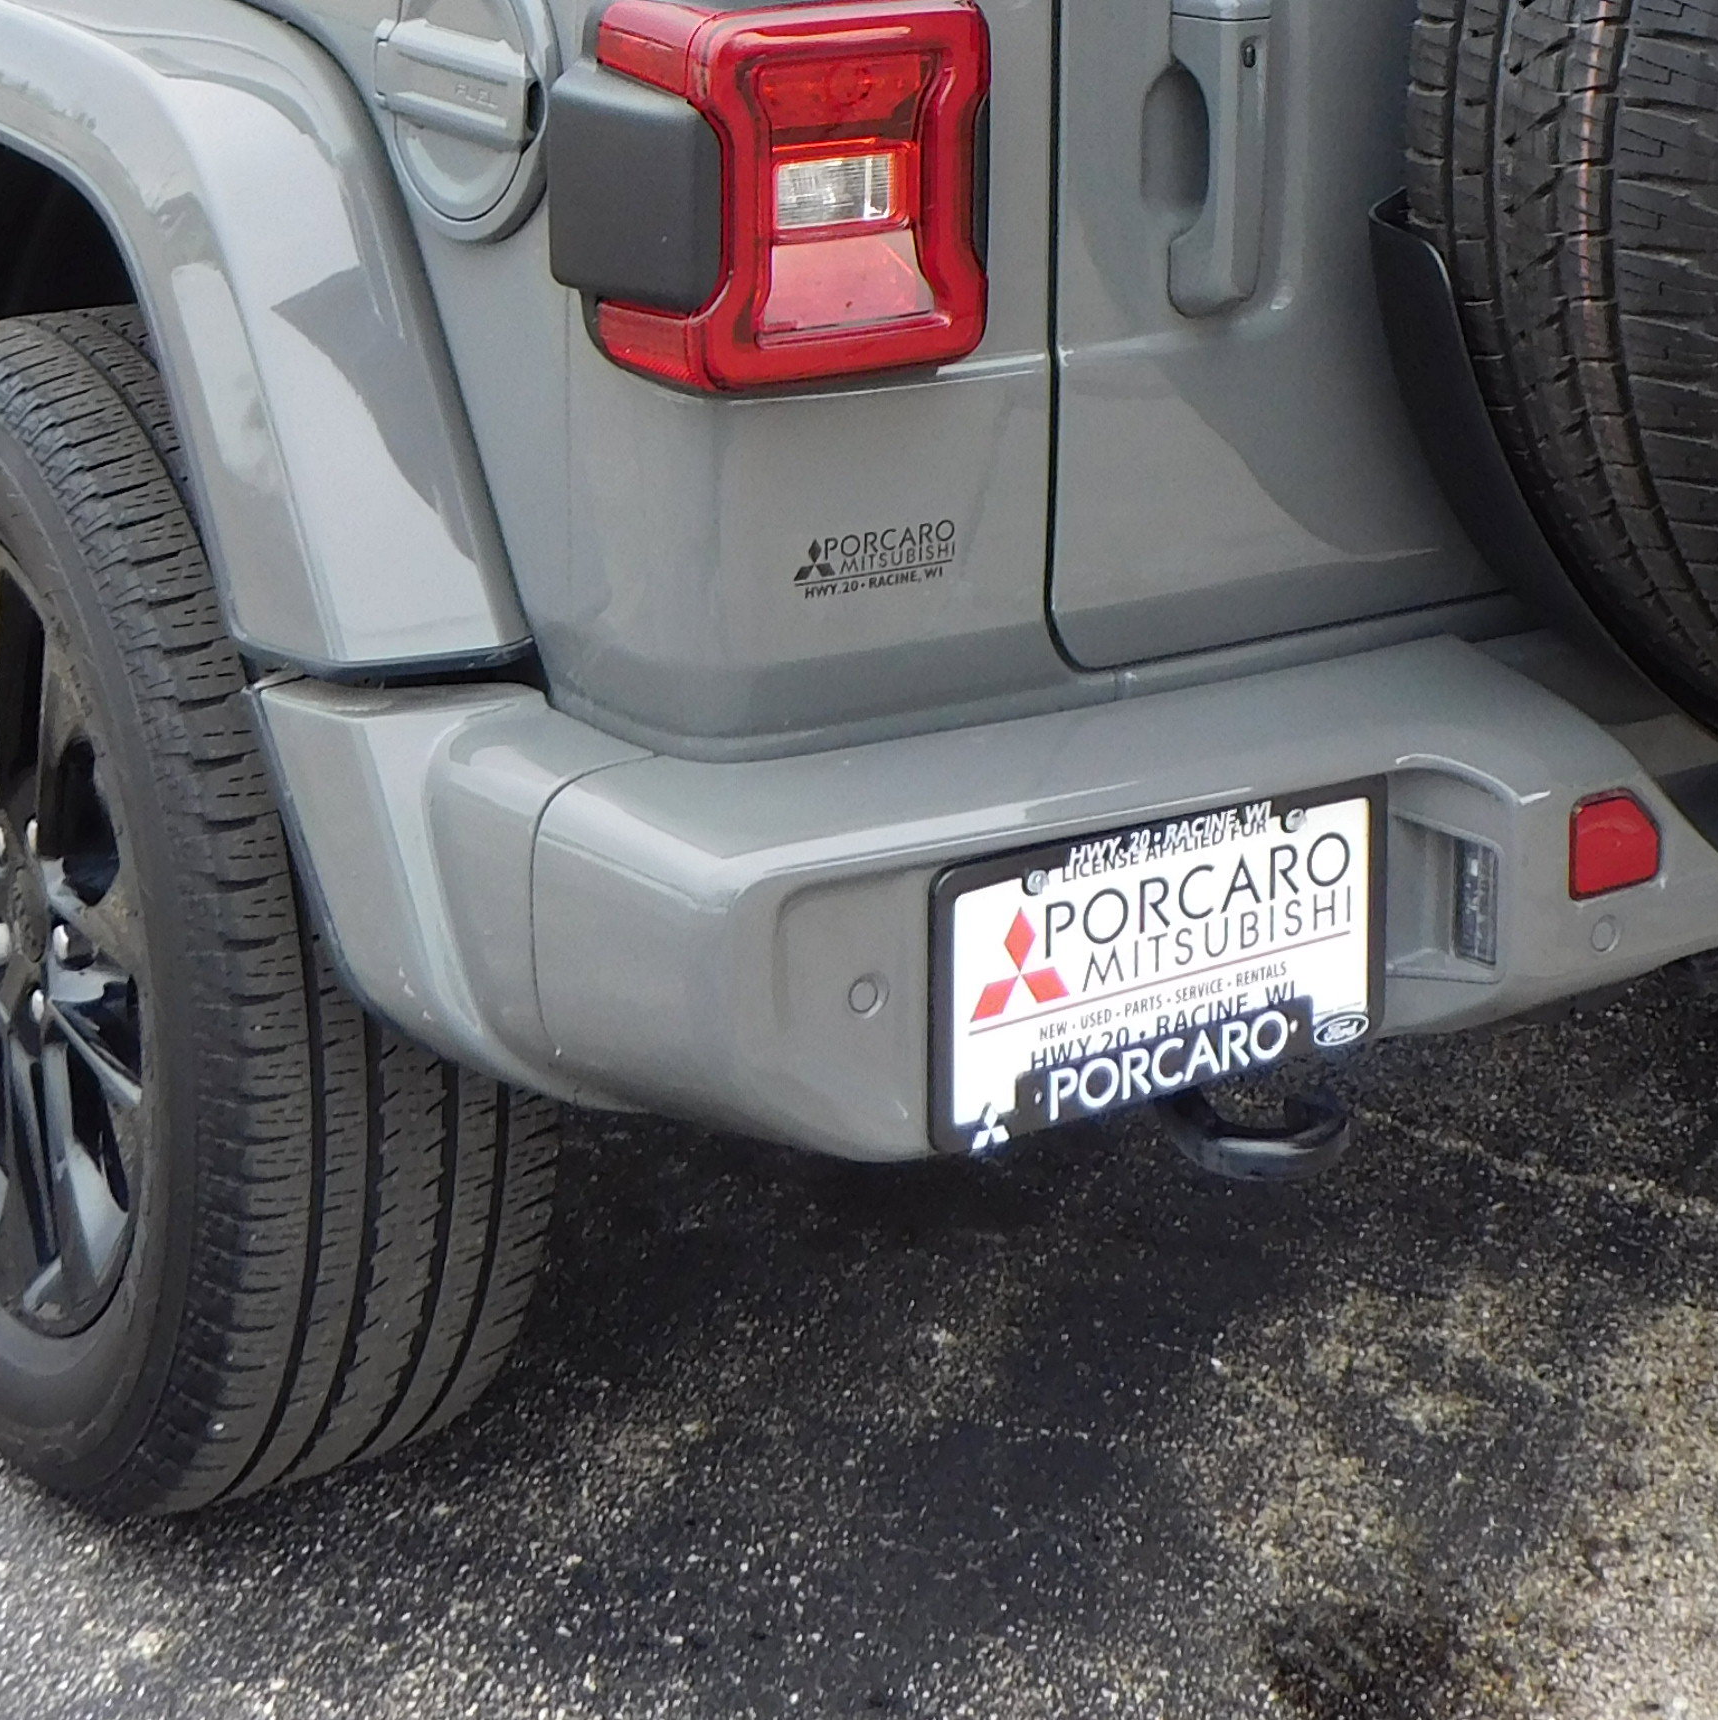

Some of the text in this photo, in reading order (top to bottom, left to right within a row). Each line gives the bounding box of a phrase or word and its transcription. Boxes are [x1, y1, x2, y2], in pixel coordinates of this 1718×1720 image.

[824, 519, 955, 560] PORCARO
[839, 541, 956, 574] MITSUBISHI
[843, 581, 859, 594] 20
[925, 566, 943, 579] WI
[1063, 818, 1267, 882] LICENSE APPLIED FOR
[1129, 829, 1151, 852] 20
[1245, 801, 1272, 821] WI
[1045, 832, 1350, 959] PORCARO
[1082, 886, 1351, 993] MITSUBISHI
[1039, 961, 1287, 1041] NEW USED PARTS SERVICE RENTALS
[1102, 1025, 1129, 1051] 20
[1265, 981, 1295, 1006] WI
[1049, 1010, 1288, 1121] PORCARO
